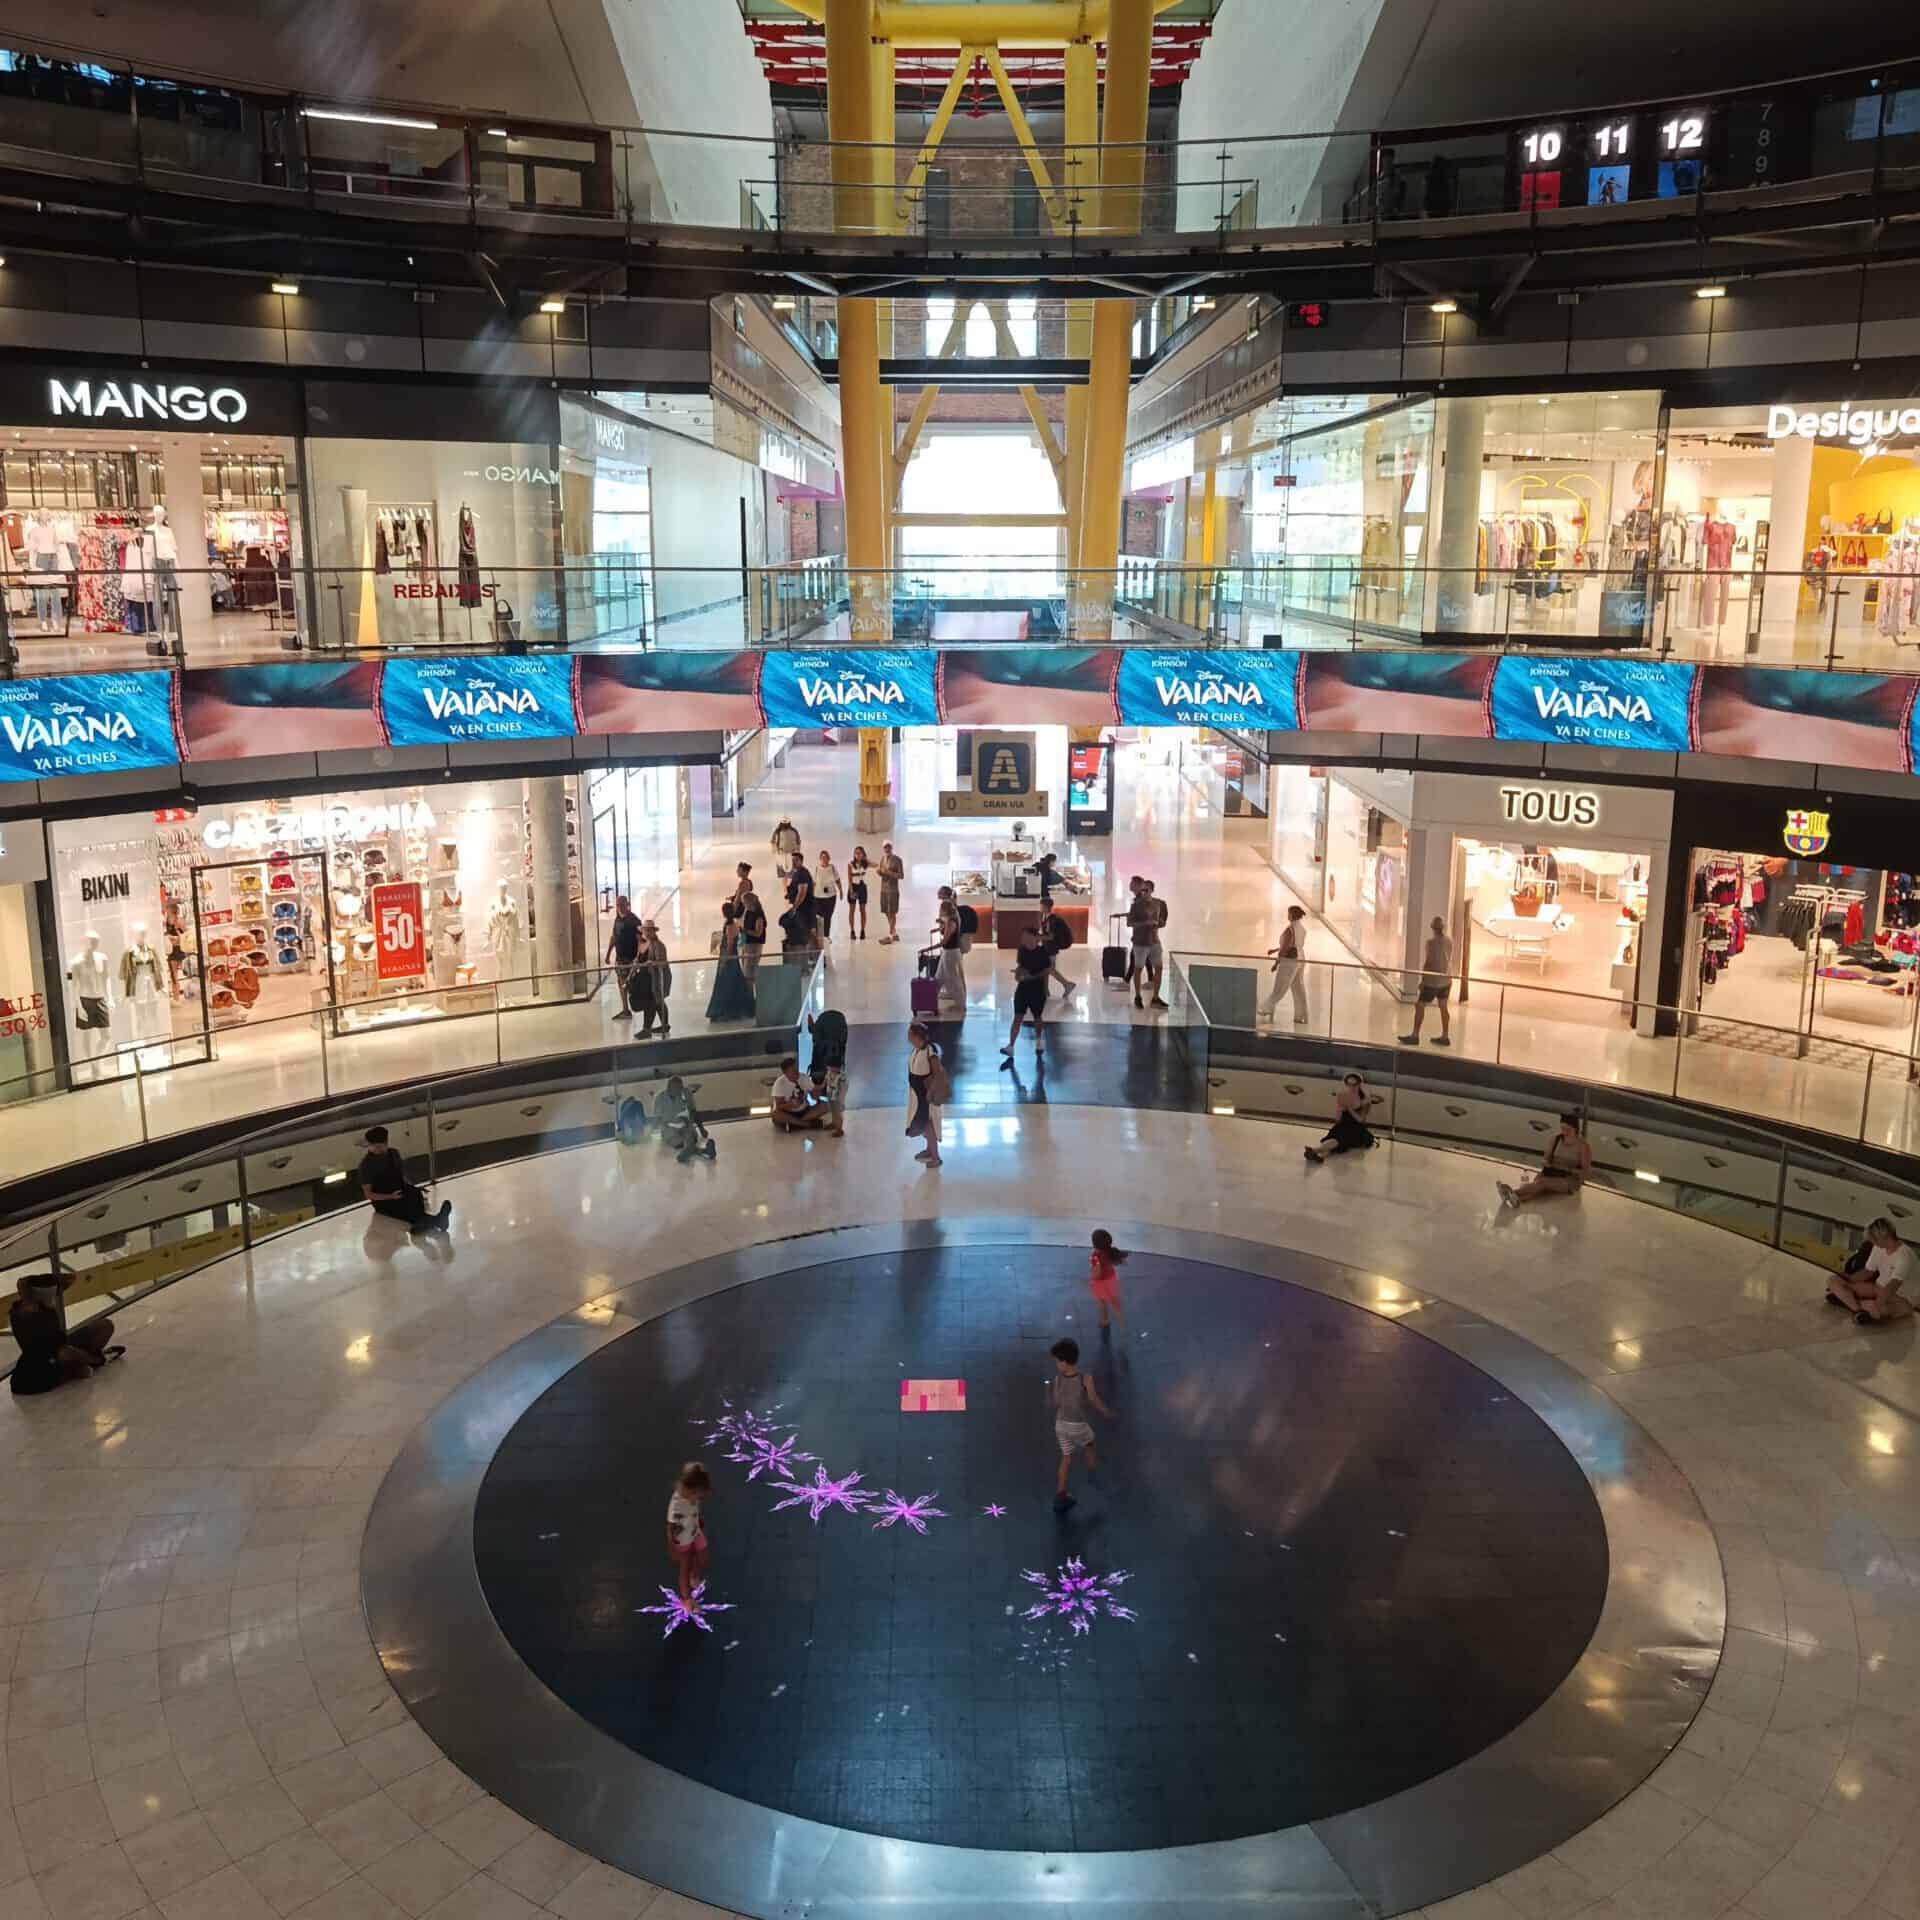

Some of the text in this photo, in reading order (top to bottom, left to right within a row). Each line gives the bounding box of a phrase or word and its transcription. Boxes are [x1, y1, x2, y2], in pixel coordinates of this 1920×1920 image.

[1760, 103, 1774, 121] 7
[1524, 132, 1562, 163] 10
[1596, 125, 1628, 156] 11
[1663, 119, 1702, 150] 12
[1757, 128, 1771, 147] 8
[1755, 155, 1768, 174] 9
[49, 379, 248, 423] MANGO
[422, 687, 541, 720] VAIANA
[797, 677, 906, 707] VAIANA
[1154, 676, 1264, 707] VAIANA
[1533, 685, 1653, 723] VAIANA
[449, 722, 523, 736] YA EN CINES
[821, 711, 888, 722] YA EN CINES
[1176, 711, 1246, 722] YA EN CINES
[1, 711, 137, 753] VAIANA
[1555, 725, 1631, 740] YA EN CINES
[33, 752, 117, 771] YA EN CINES
[1502, 788, 1597, 825] TOUS
[81, 872, 130, 901] BIKINI
